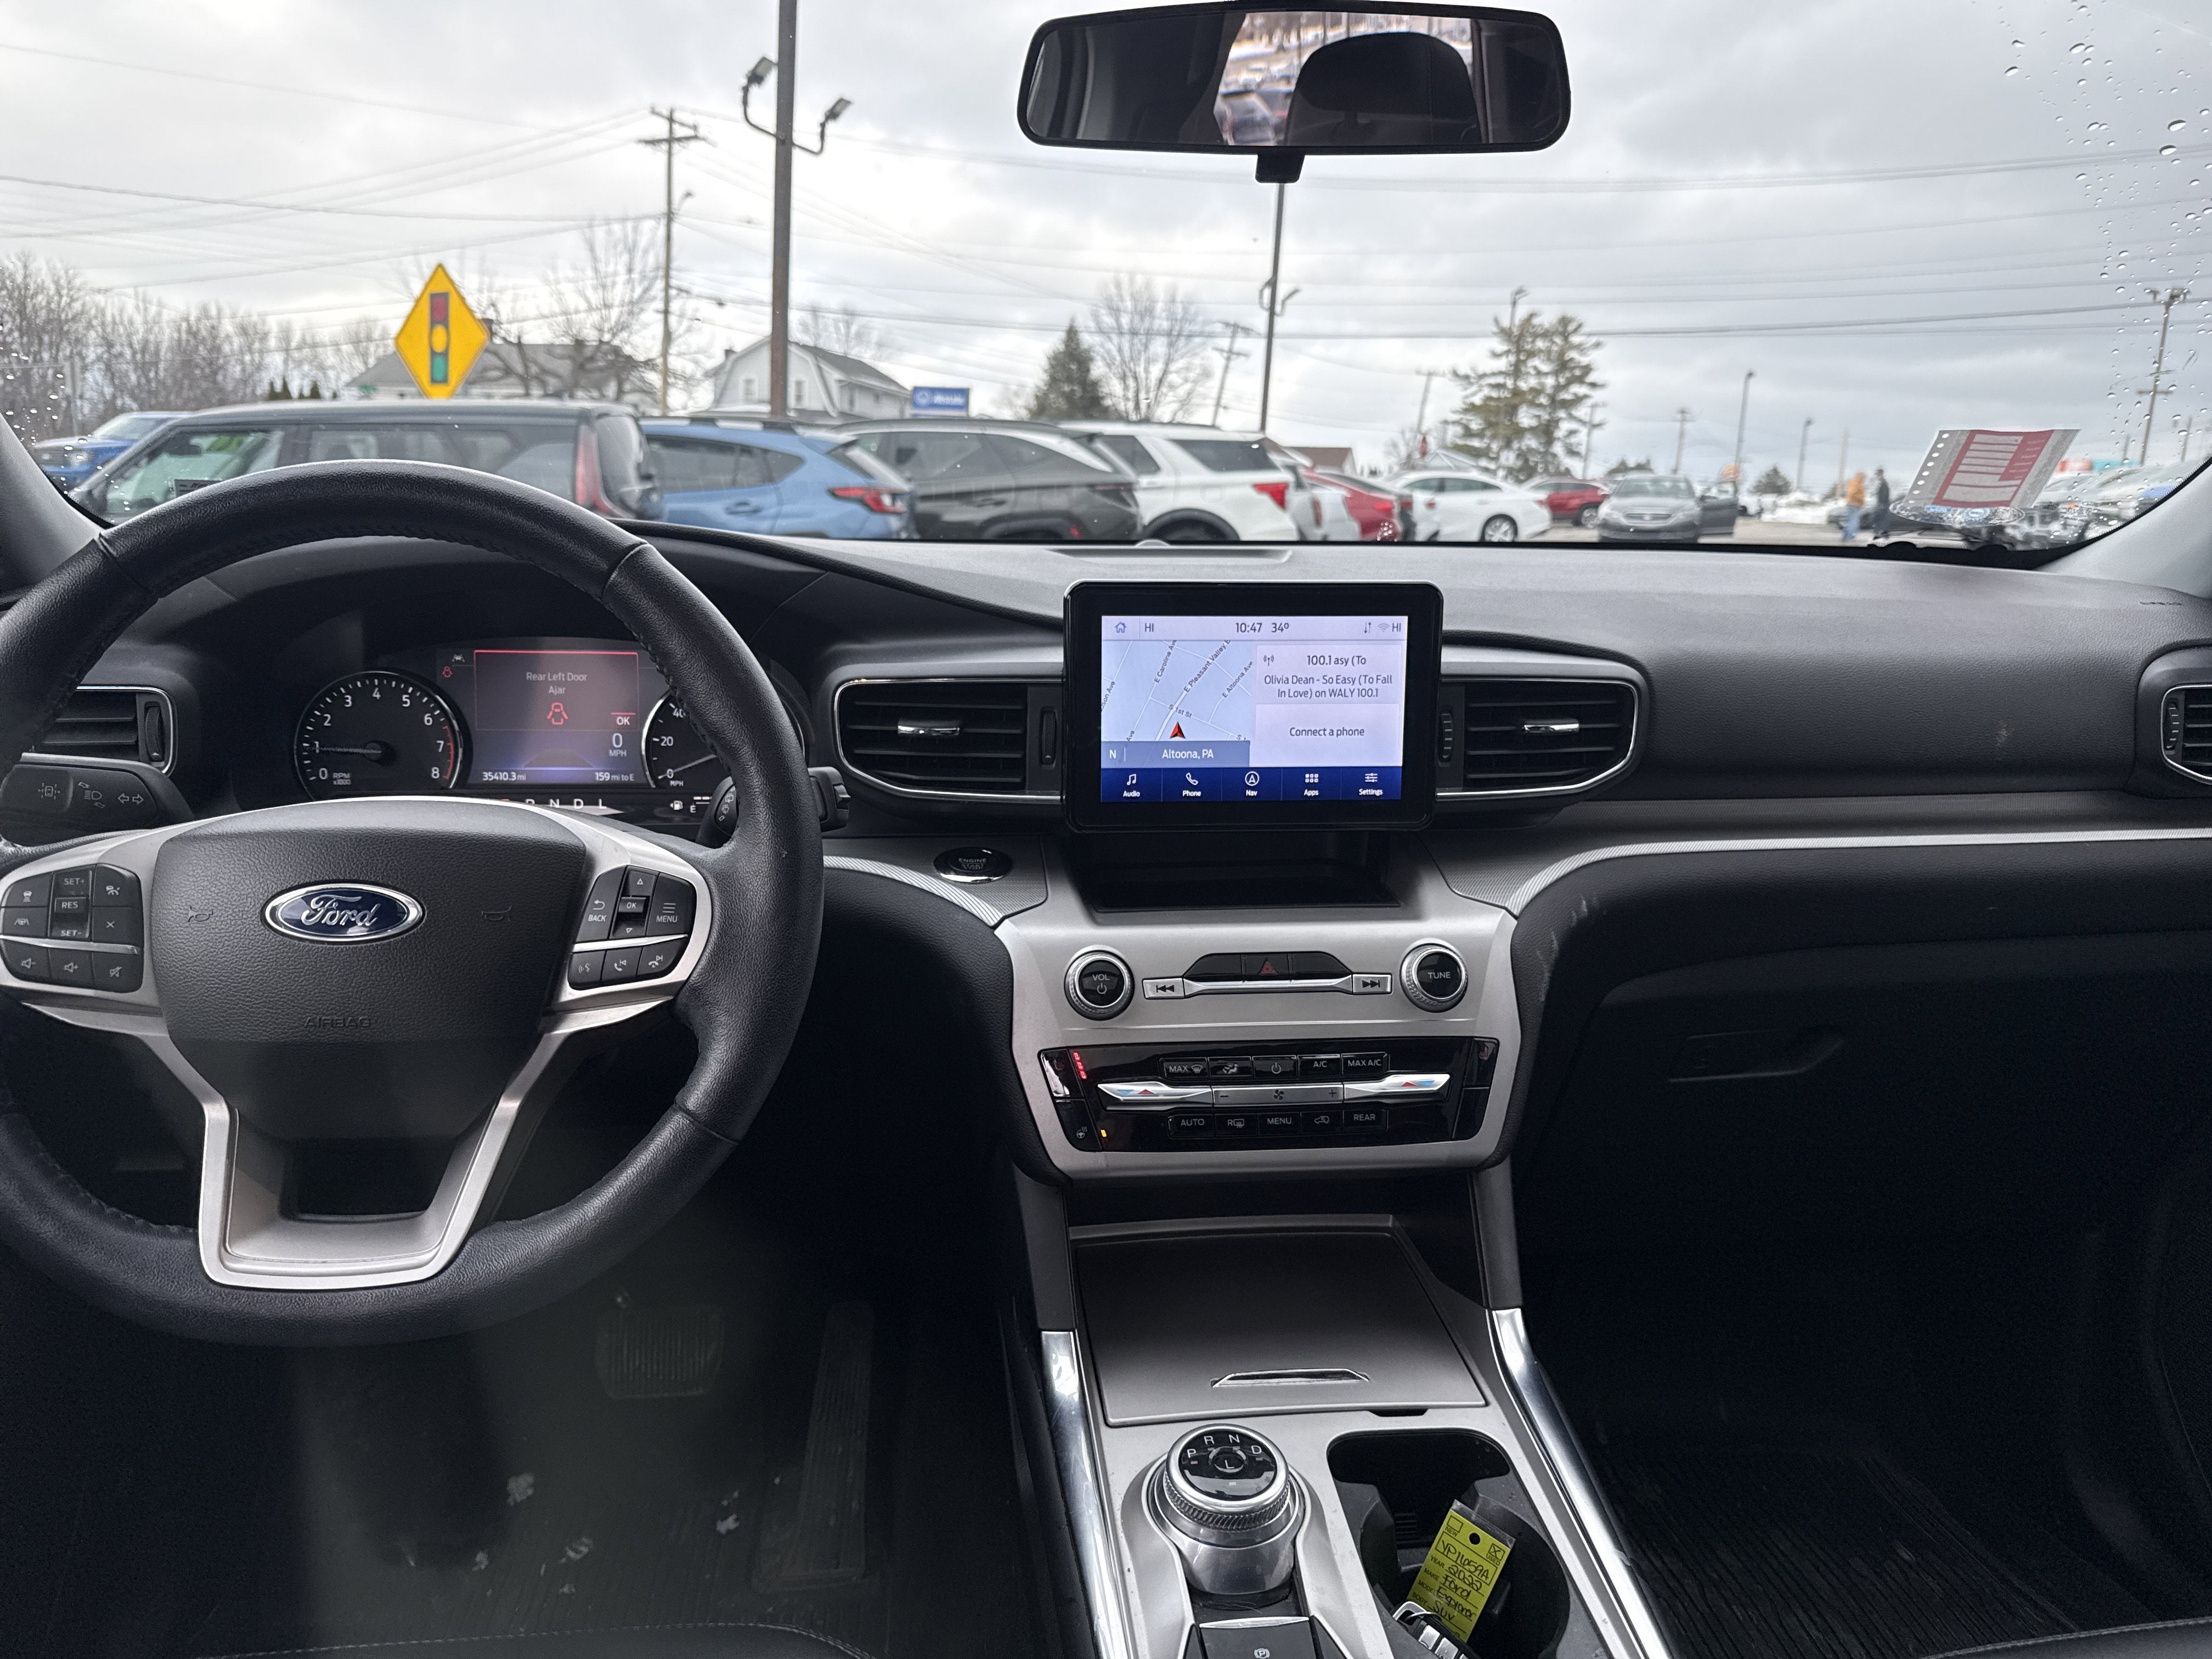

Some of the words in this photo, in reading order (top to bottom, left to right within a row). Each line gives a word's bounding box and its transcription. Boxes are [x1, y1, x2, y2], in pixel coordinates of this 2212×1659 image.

[1144, 623, 1154, 633] HI
[1235, 623, 1262, 633] 10:47
[1392, 623, 1402, 633] HI
[1157, 651, 1171, 677] Caroline
[1188, 661, 1211, 687] Pleasant
[1209, 644, 1226, 662] Valley
[1307, 655, 1331, 665] 100.1
[1334, 657, 1349, 667] asy
[1352, 655, 1366, 667] (To
[526, 672, 546, 681] Rear
[548, 672, 566, 681] Left
[567, 673, 588, 681] Door
[1226, 672, 1245, 694] Altoona
[1244, 661, 1252, 672] Ave
[1264, 675, 1289, 685] Olivia
[1291, 676, 1314, 685] Dean
[1322, 675, 1334, 685] So
[1336, 675, 1356, 686] Easy
[1358, 675, 1374, 686] (To
[1376, 675, 1392, 684] Fall
[548, 686, 566, 695] Ajar
[1106, 681, 1115, 693] Ave
[373, 688, 381, 699] 4
[1278, 689, 1286, 698] In
[1288, 688, 1312, 699] Love)
[1329, 689, 1355, 698] WALY
[1357, 688, 1378, 698] 100.1
[345, 696, 352, 707] 3
[402, 695, 410, 707] 5
[1175, 707, 1184, 715] 1st
[323, 714, 332, 726] 2
[424, 714, 433, 726] 6
[617, 716, 630, 726] OK
[1289, 727, 1327, 737] Connect
[1336, 727, 1365, 738] phone
[612, 733, 623, 748] 0
[661, 736, 673, 746] 20
[314, 742, 319, 753] 1
[437, 741, 444, 752] 7
[1109, 749, 1116, 759] N
[1162, 749, 1200, 760] Altoona,
[1202, 749, 1214, 758] PA
[319, 768, 328, 780] 0
[431, 768, 439, 779] 8
[482, 772, 516, 781] 35410.3
[595, 772, 610, 781] 159
[1304, 789, 1319, 798] Apps
[1358, 788, 1383, 797] Settings
[550, 799, 560, 808] N
[574, 799, 584, 809] D
[599, 799, 607, 809] L
[301, 894, 381, 927] Ford
[1427, 971, 1451, 980] TUNE
[304, 1017, 371, 1028] AIRBAG
[1204, 1436, 1214, 1444] R
[1187, 1449, 1197, 1458] P
[1251, 1446, 1262, 1454] D
[1224, 1460, 1235, 1469] L
[1444, 1526, 1458, 1537] NEW
[1486, 1554, 1500, 1566] USED
[1431, 1555, 1444, 1568] YEAR
[1448, 1565, 1482, 1592] 2022
[1418, 1580, 1436, 1596] MODEL
[1424, 1568, 1439, 1581] MAKE
[1443, 1574, 1471, 1600] Ford
[1412, 1593, 1427, 1604] BODY
[1433, 1600, 1455, 1621] SUV
